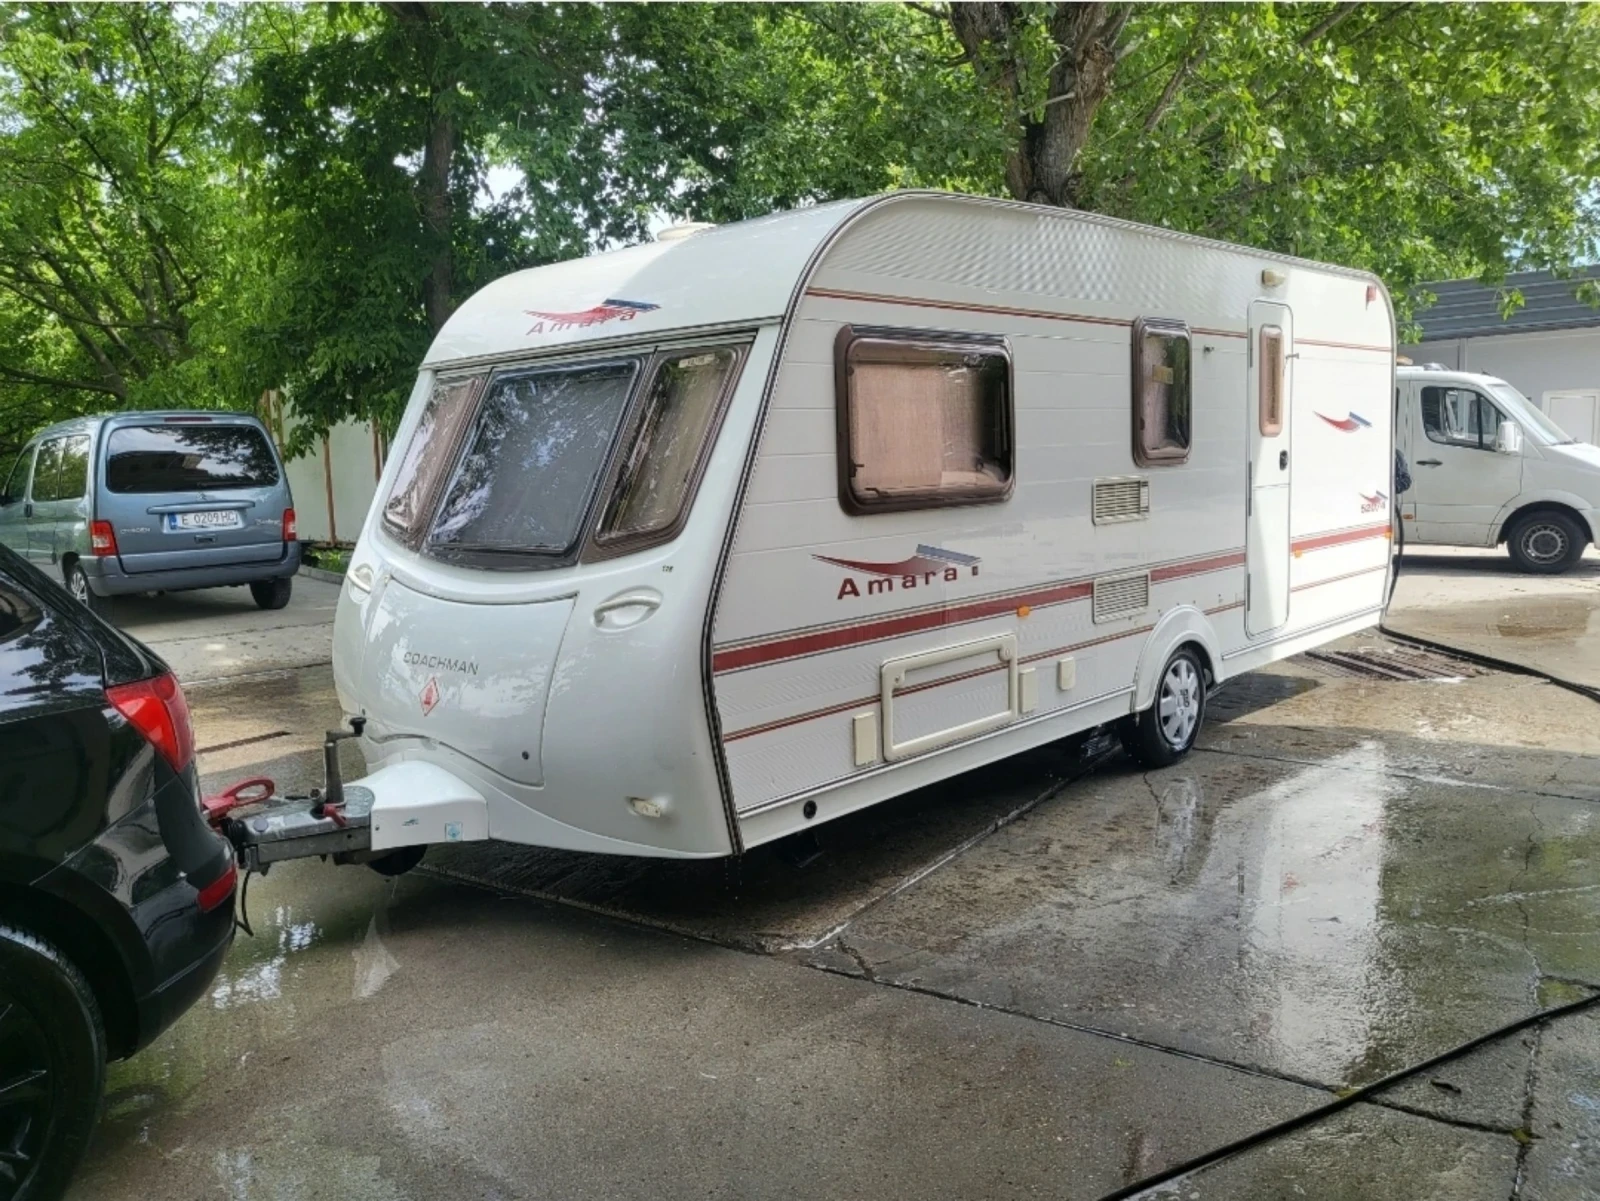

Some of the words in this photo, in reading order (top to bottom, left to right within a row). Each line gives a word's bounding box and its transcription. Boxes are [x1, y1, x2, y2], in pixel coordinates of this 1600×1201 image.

[526, 309, 636, 335] Amara
[181, 515, 189, 525] E
[194, 512, 219, 524] 0209
[837, 567, 957, 600] Amara
[403, 651, 479, 675] COACHMAN
